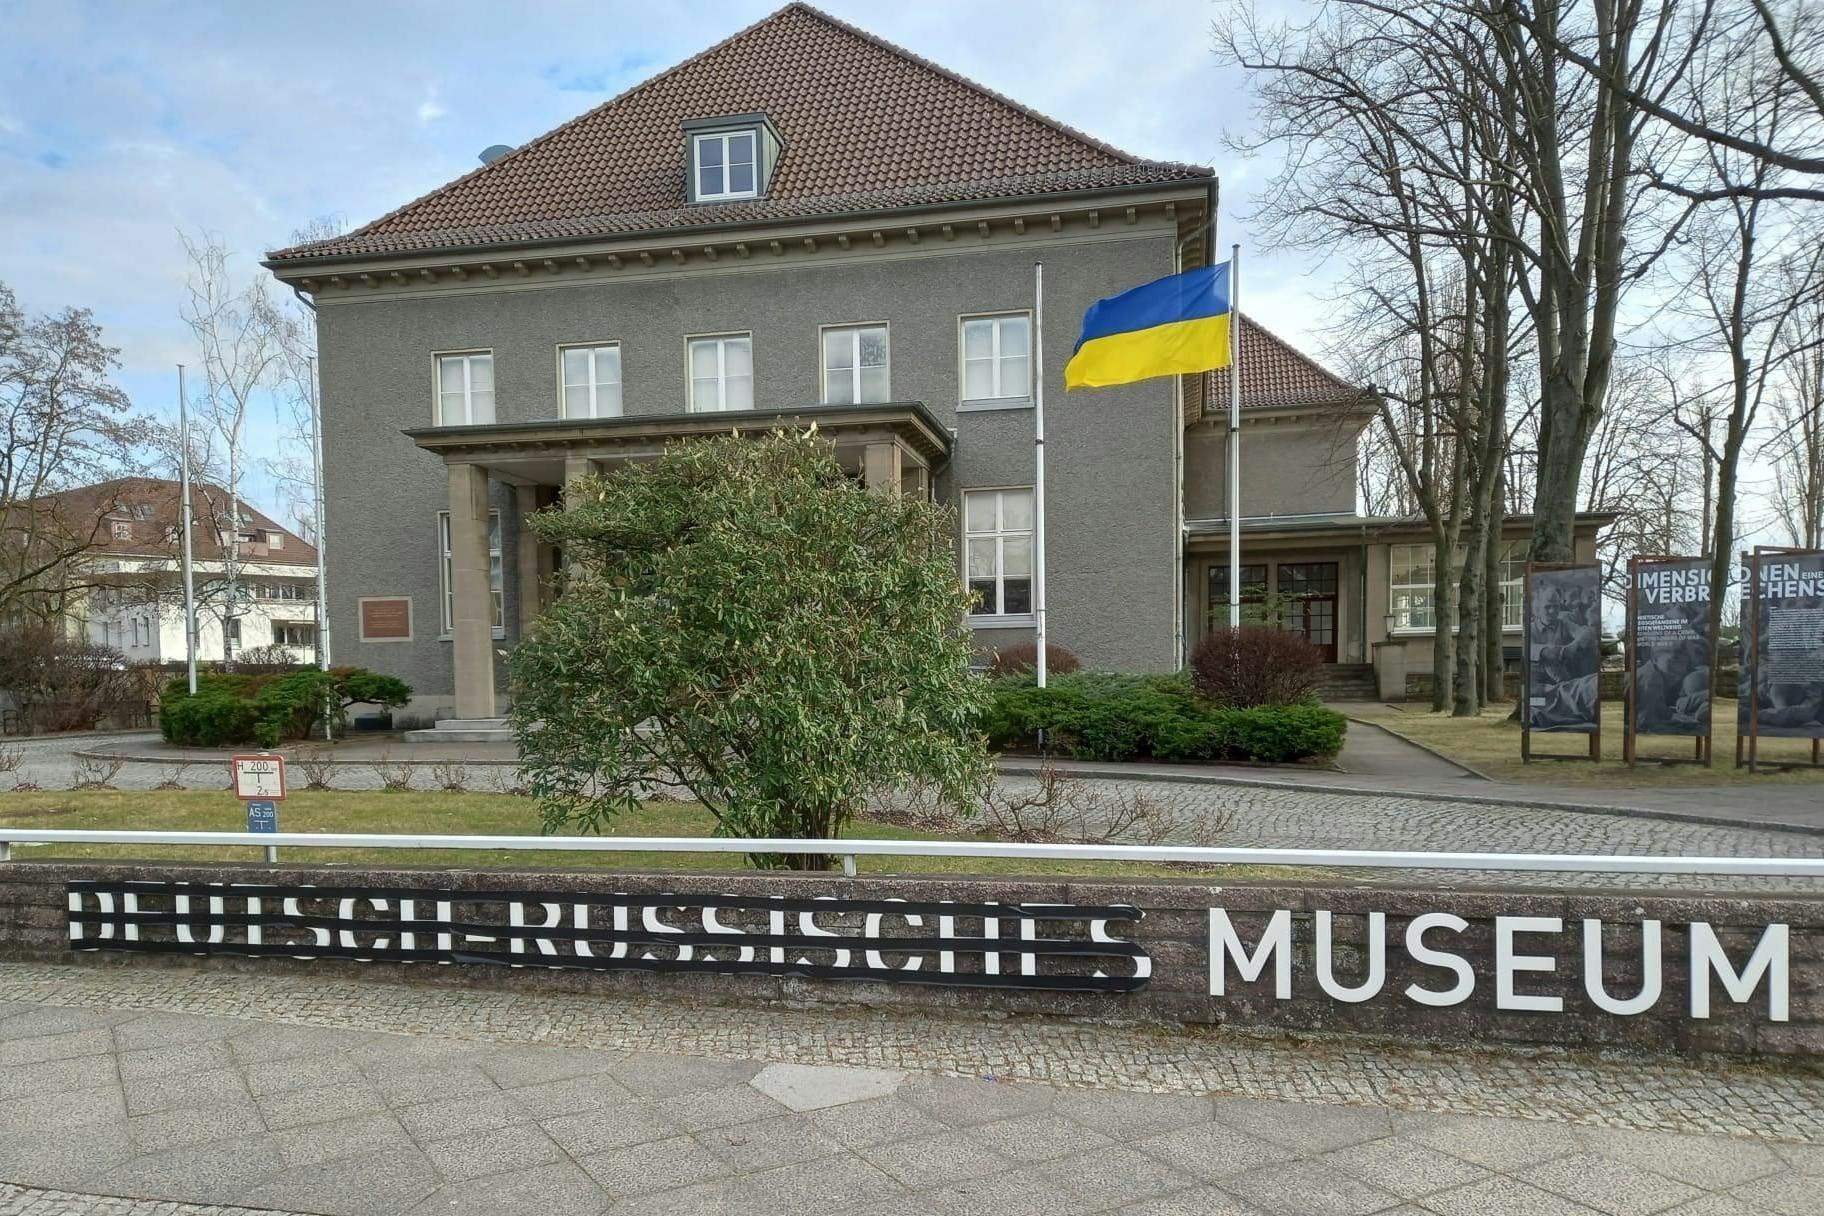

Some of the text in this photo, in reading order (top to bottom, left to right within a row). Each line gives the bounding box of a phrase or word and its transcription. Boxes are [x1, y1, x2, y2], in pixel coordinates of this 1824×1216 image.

[237, 762, 269, 771] H 200
[249, 807, 261, 817] AS
[1208, 907, 1790, 1022] MUSEUM
